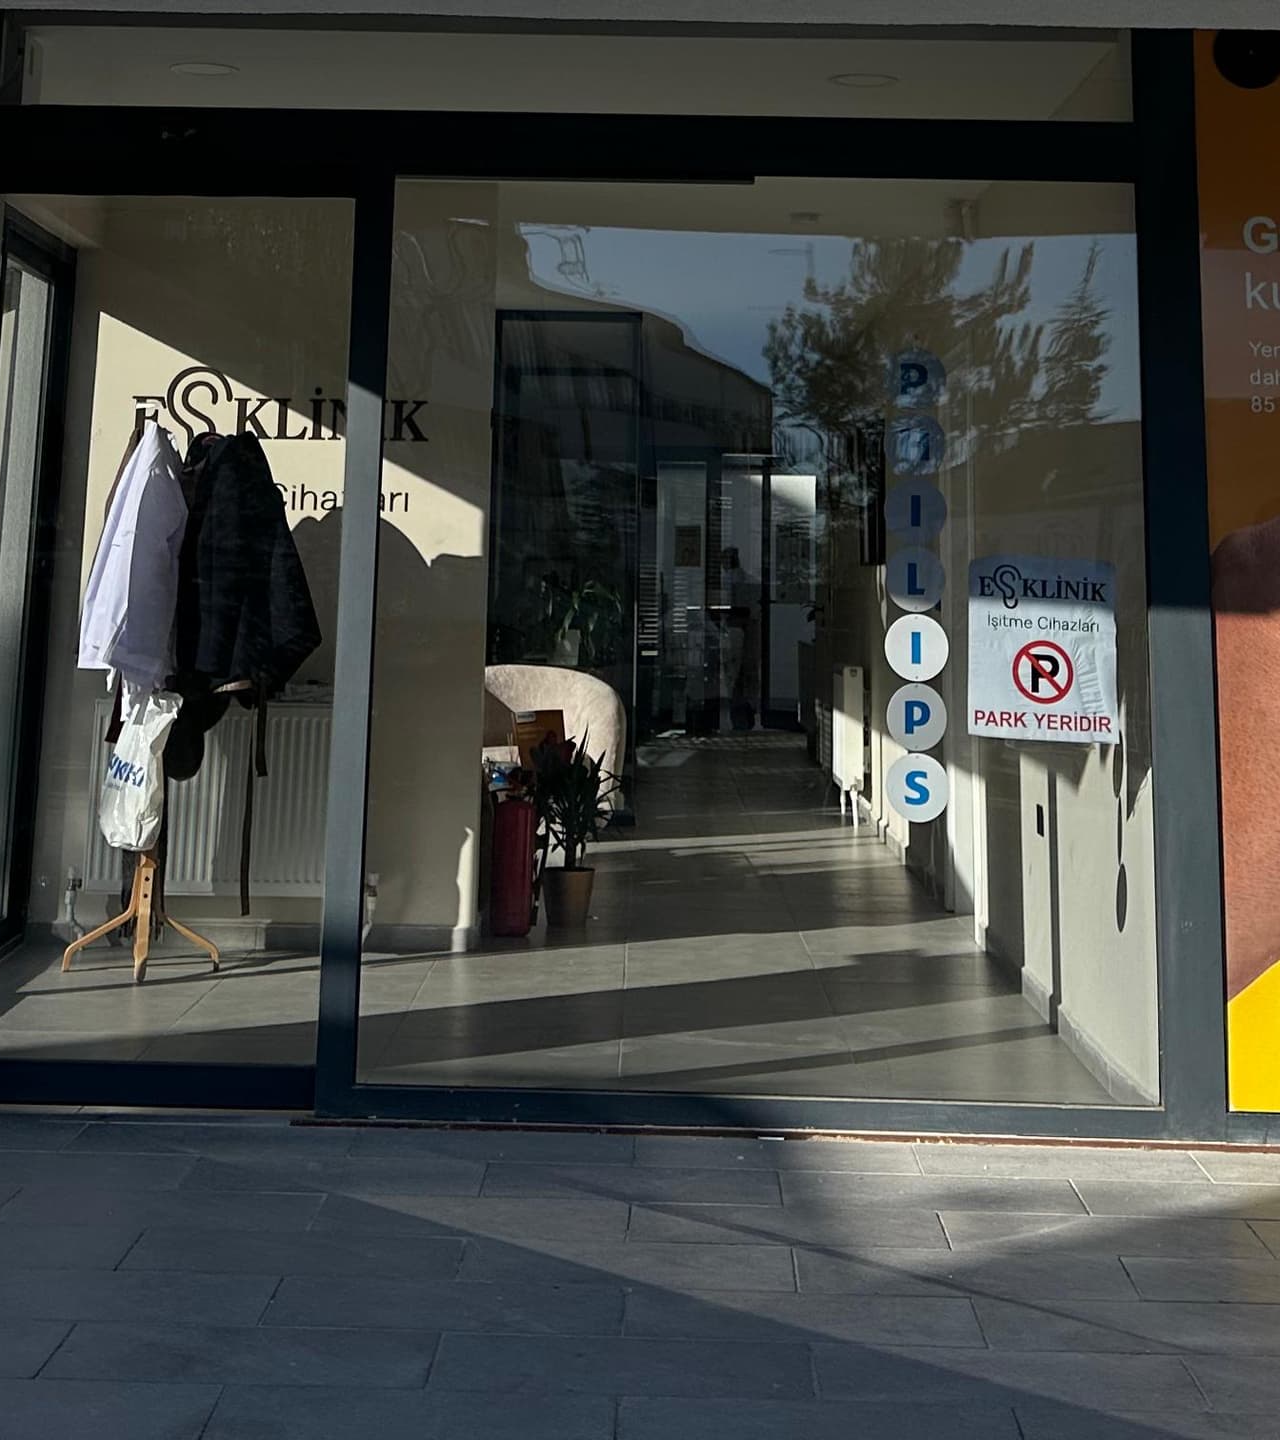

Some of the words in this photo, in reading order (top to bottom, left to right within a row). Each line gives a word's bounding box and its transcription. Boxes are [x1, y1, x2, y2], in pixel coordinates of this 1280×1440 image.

[1250, 396, 1275, 413] 85
[987, 611, 1034, 631] İşitme
[1037, 616, 1100, 634] Cihazları
[974, 709, 1027, 728] PARK
[1033, 711, 1112, 733] YERİDİR
